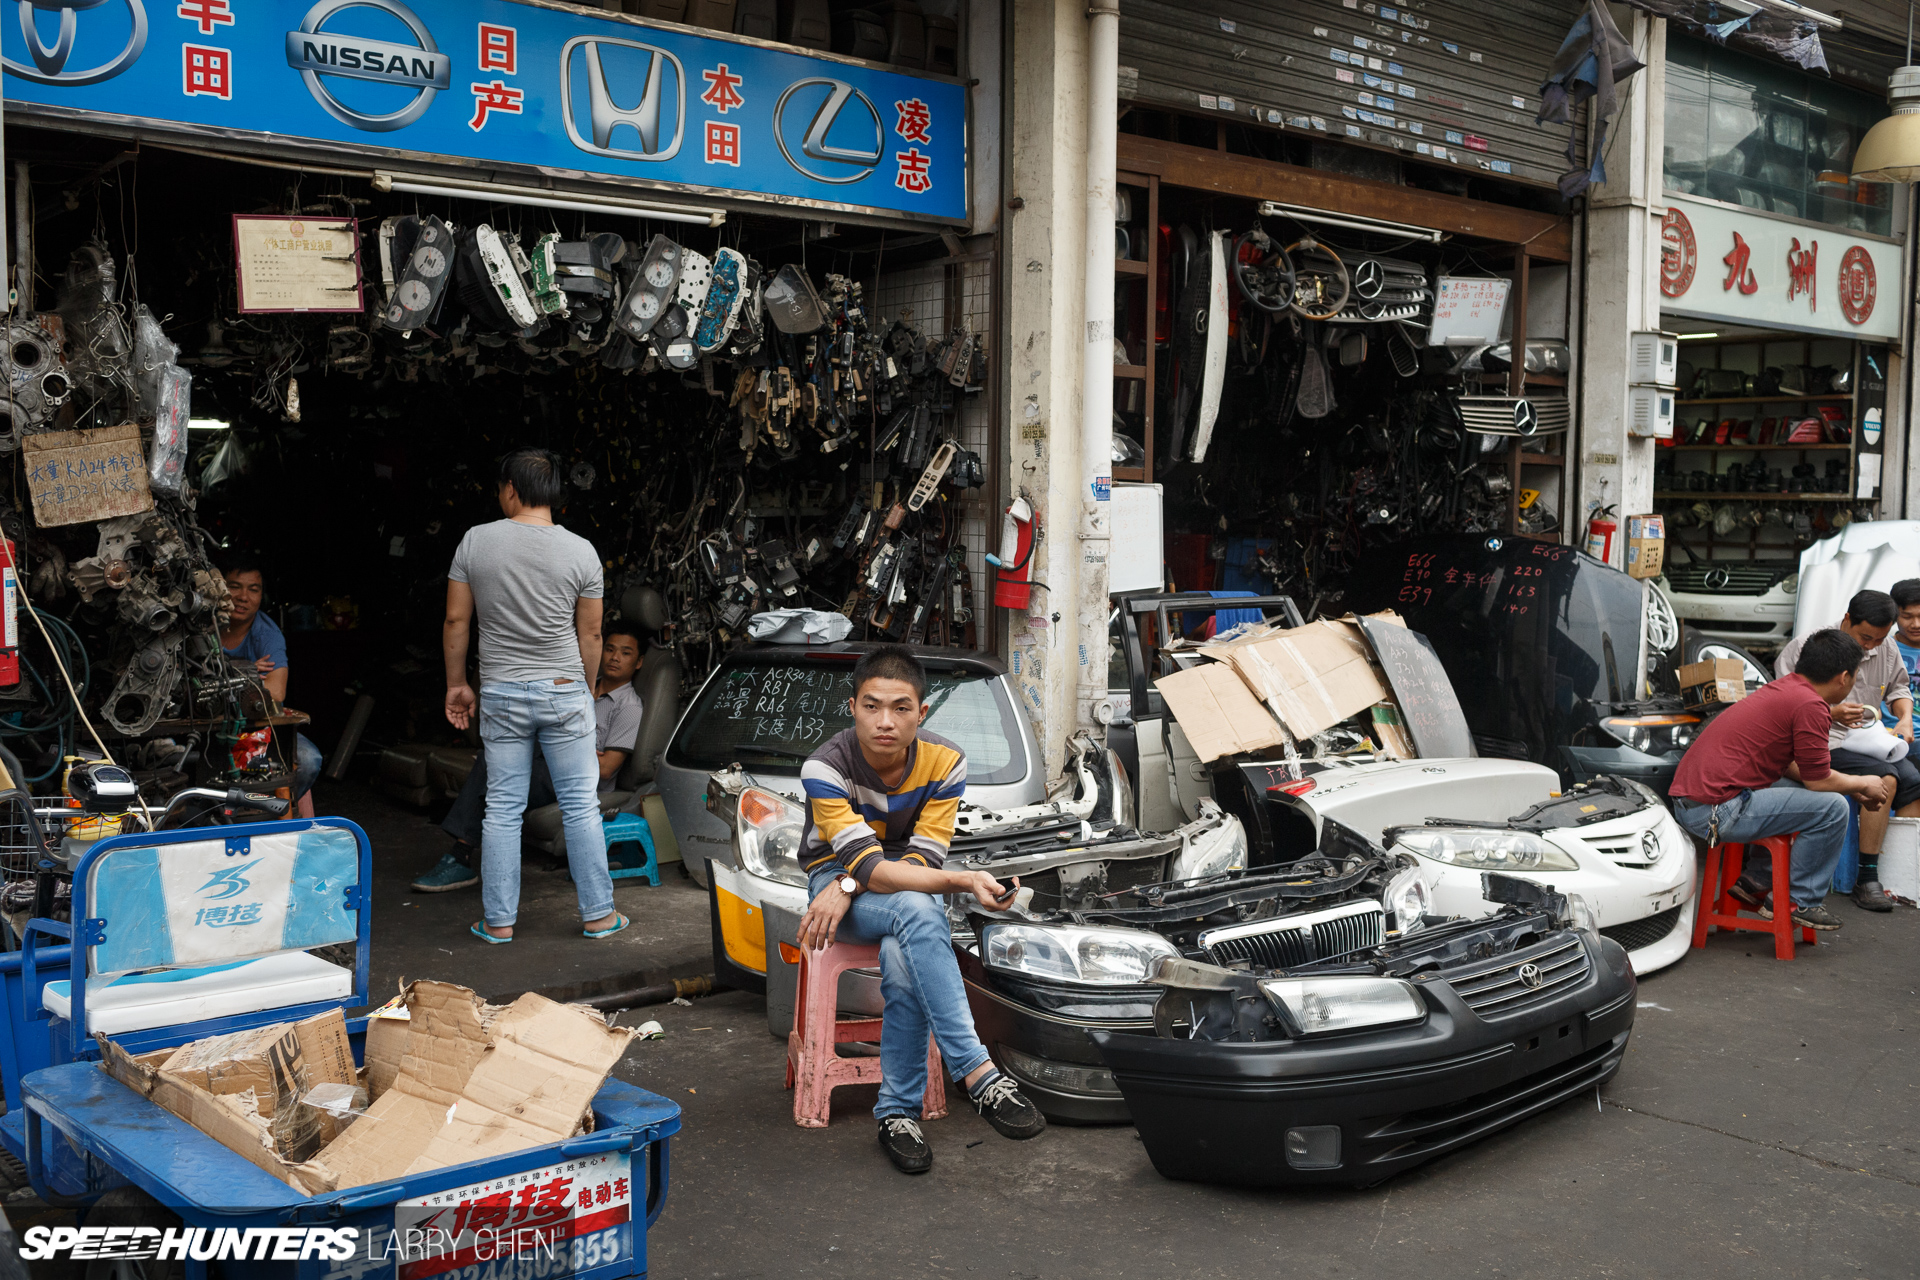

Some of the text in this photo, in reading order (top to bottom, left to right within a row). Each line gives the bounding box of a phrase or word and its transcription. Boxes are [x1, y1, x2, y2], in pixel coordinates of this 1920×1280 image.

[302, 40, 435, 80] NISSAN
[468, 22, 524, 132] 日产
[701, 63, 745, 167] 本田
[894, 98, 932, 194] 凌志
[263, 238, 333, 251] 个体工商户营业执照
[1722, 231, 1819, 313] 九洲
[1865, 422, 1880, 430] VOLVO
[1408, 553, 1436, 568] E66
[1514, 566, 1543, 576] 220
[1403, 569, 1431, 582] E90
[1398, 586, 1432, 606] E39
[1509, 584, 1536, 597] 163
[1503, 602, 1528, 615] 140
[761, 680, 791, 696] RB1
[755, 695, 788, 713] RA6
[790, 716, 825, 743] A33
[194, 902, 263, 928] 博技
[432, 1158, 599, 1205] 节能环保 品质保障 百姓放心
[578, 1176, 629, 1210] 电动车
[452, 1176, 577, 1240] 博技
